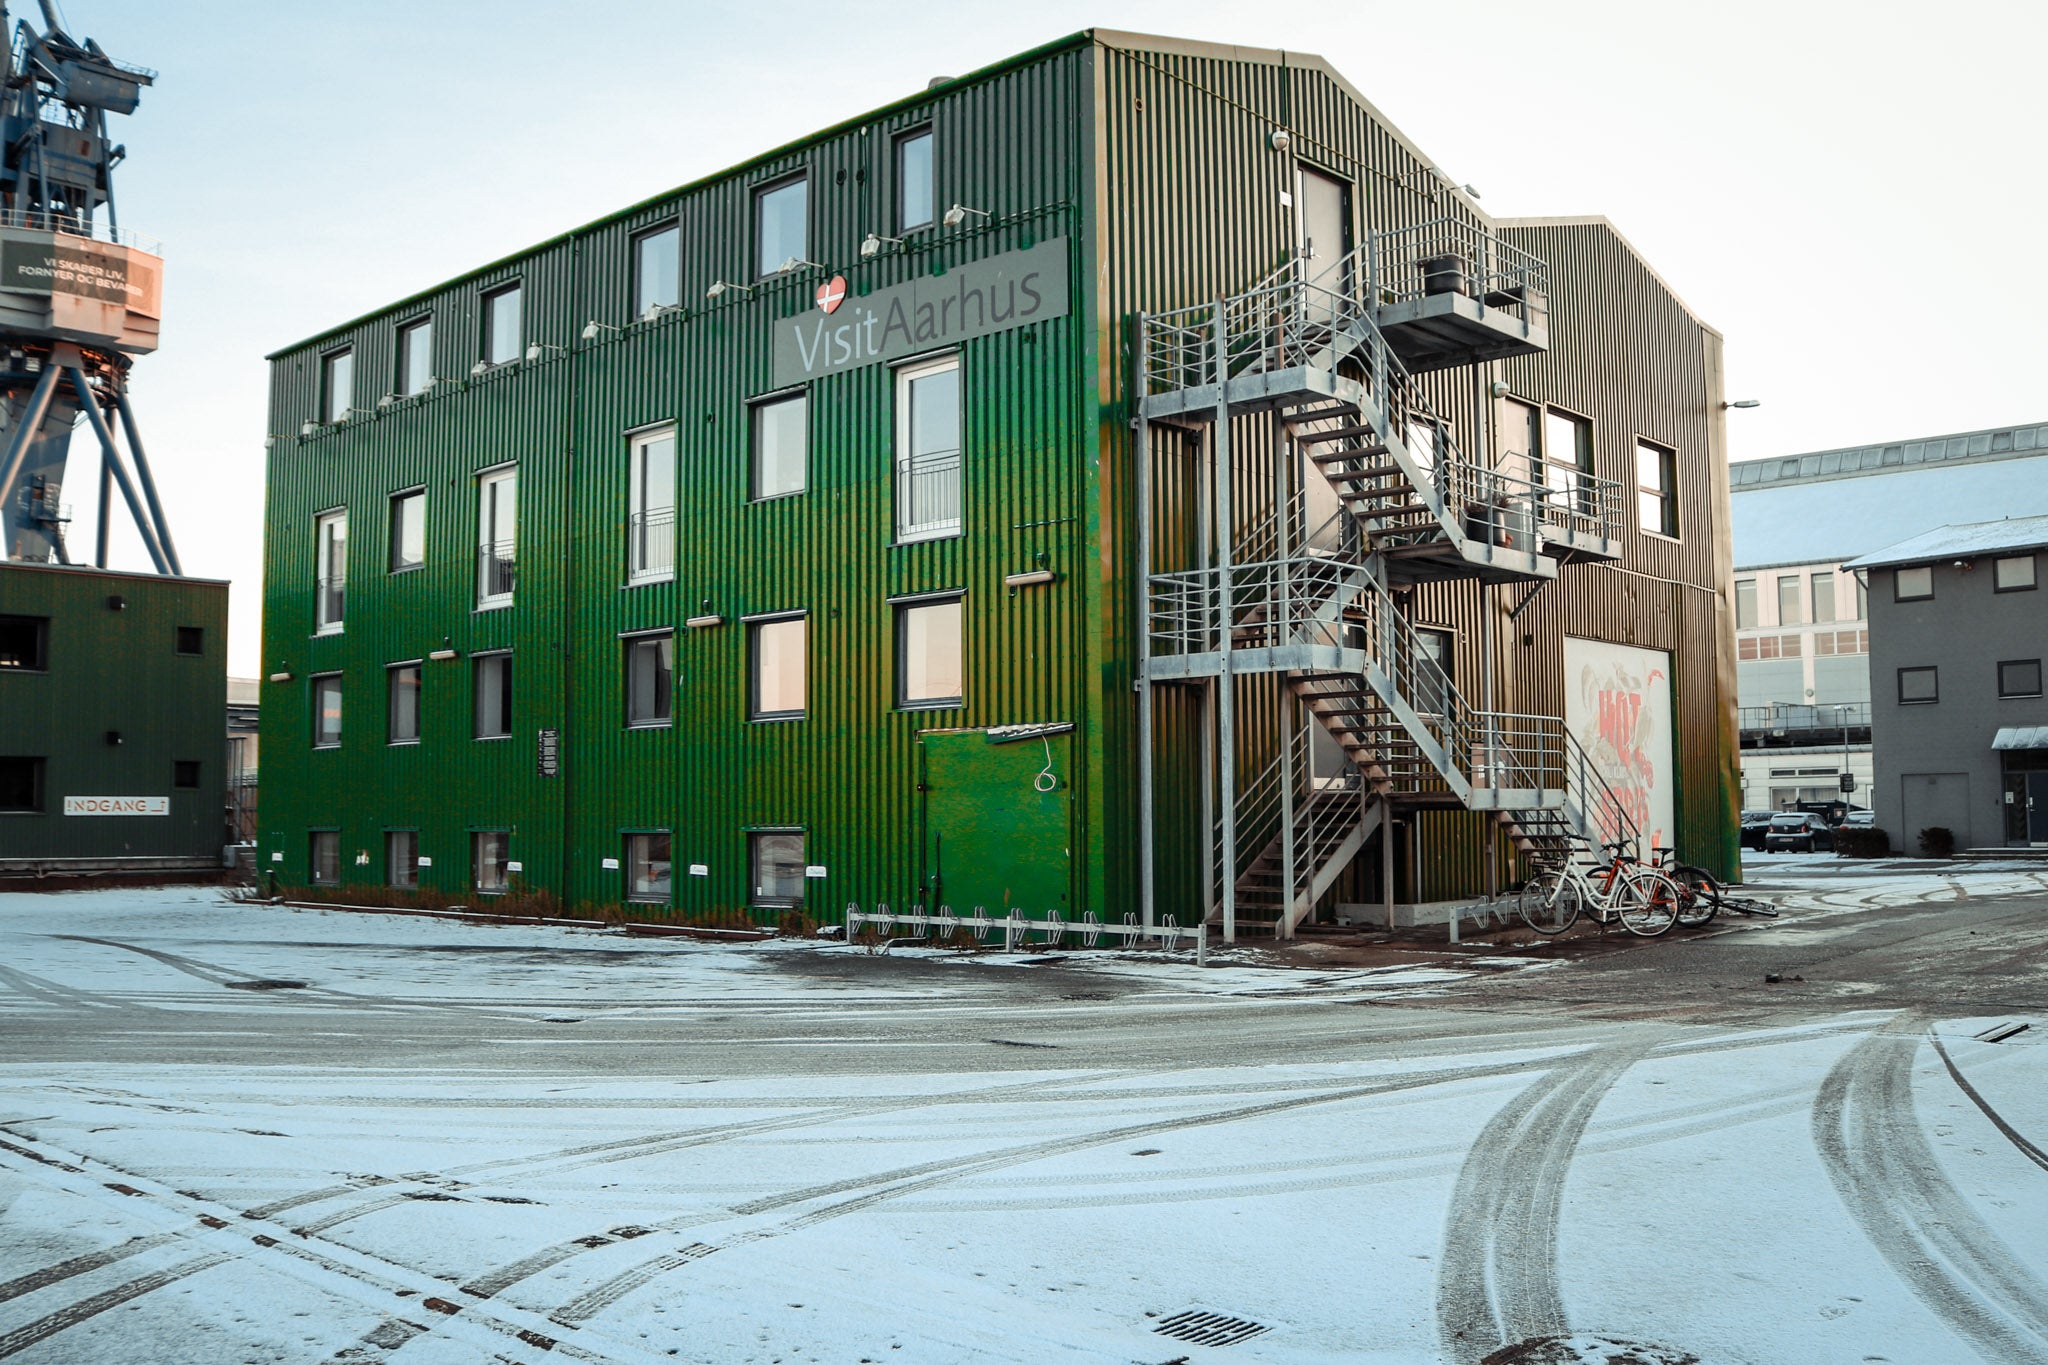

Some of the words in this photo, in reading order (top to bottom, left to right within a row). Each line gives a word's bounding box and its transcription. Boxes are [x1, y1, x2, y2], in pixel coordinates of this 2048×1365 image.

[18, 265, 74, 282] FORNYER
[76, 274, 94, 284] OG
[44, 257, 56, 267] VI
[58, 259, 104, 276] SKABER
[1599, 690, 1641, 769] HOT
[66, 800, 147, 812] INDGANG
